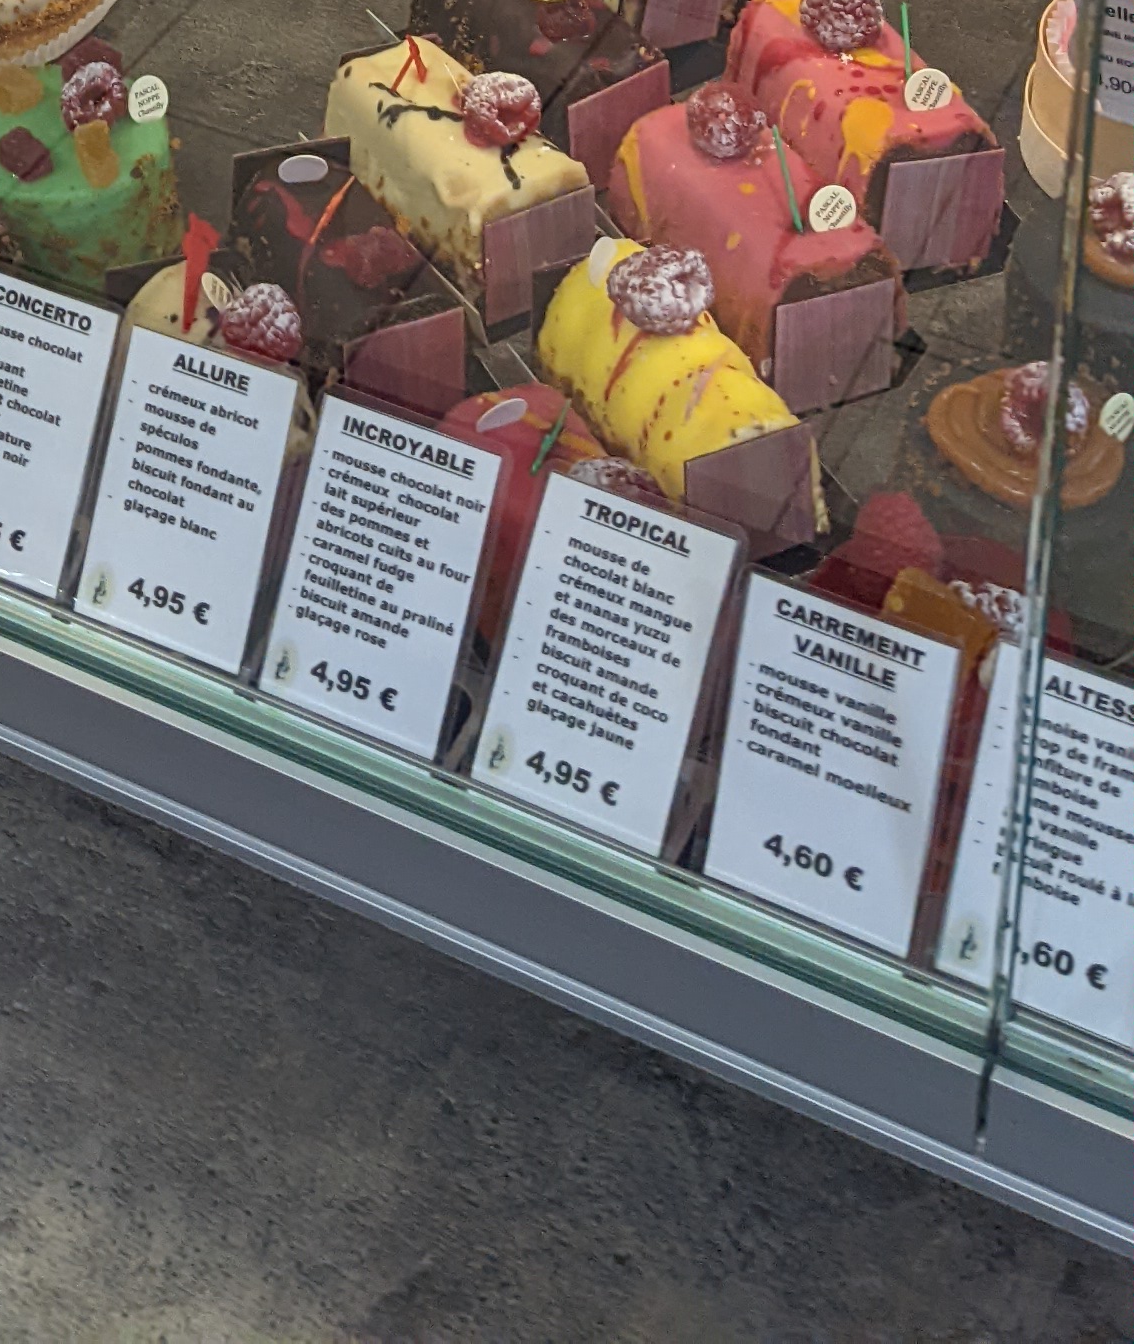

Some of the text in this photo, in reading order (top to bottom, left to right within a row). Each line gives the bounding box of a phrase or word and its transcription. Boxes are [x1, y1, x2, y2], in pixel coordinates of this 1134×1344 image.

[134, 83, 159, 99] PASCAL
[137, 93, 160, 108] NOPPE
[815, 191, 840, 217] PASCAL
[823, 198, 844, 222] NOPPE
[27, 335, 82, 363] chocolat
[173, 353, 250, 392] ALLURE
[6, 398, 61, 426] chocolat
[148, 383, 258, 429] crémeux abricot
[2, 450, 29, 466] noir
[139, 422, 198, 450] spéculos
[342, 414, 475, 476] INCROYABLE
[131, 457, 254, 512] biscuit fondant au
[331, 450, 486, 513] mousse chocolat noir
[8, 529, 26, 551] €
[123, 498, 216, 540] glaçage blanc
[584, 498, 690, 554] TROPICAL
[312, 536, 414, 582] caramel fudge
[568, 536, 650, 575] mousse de
[127, 577, 210, 625] 4,95 €
[563, 555, 675, 605] chocolat blanc
[299, 585, 409, 638] biscuit amande
[776, 598, 926, 666] CARREMENT
[794, 634, 896, 688] VANILLE
[310, 660, 398, 711] 4,95 €
[758, 663, 897, 725] mousse vanille
[753, 698, 898, 767] biscuit chocolat
[755, 682, 902, 748] crémeux vanille
[525, 750, 620, 806] 4,95 €
[1067, 749, 1088, 764] de
[1038, 819, 1098, 850] vanille
[763, 834, 864, 891] 4,60 €
[1059, 869, 1106, 895] roulé
[1018, 941, 1109, 990] ,60 €
